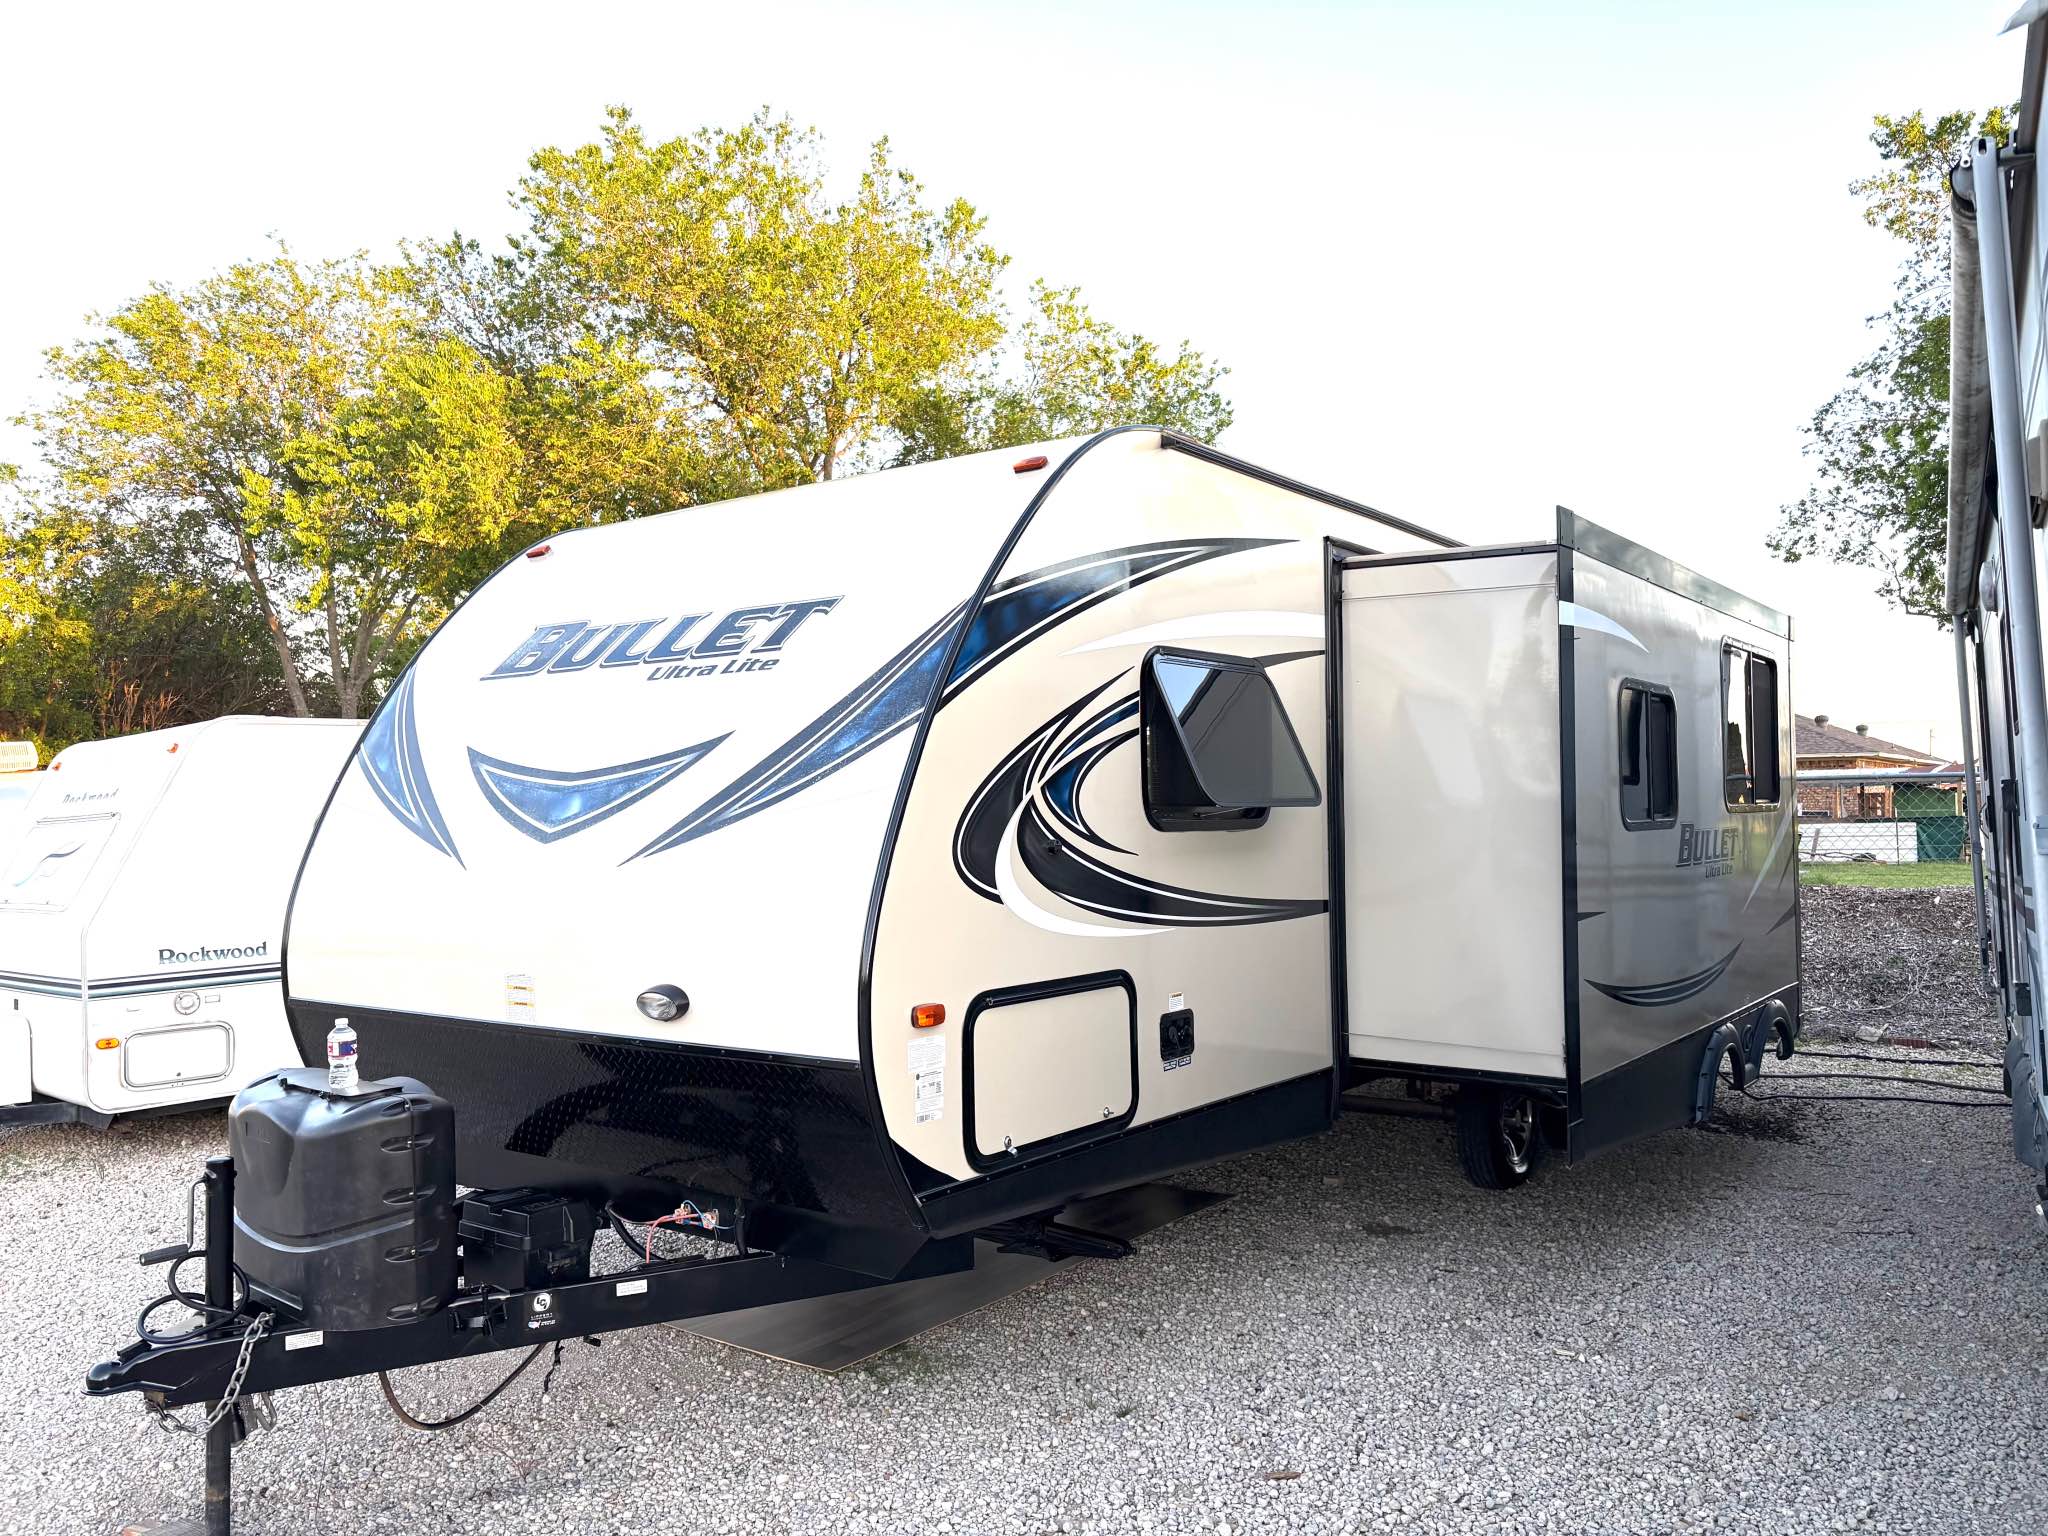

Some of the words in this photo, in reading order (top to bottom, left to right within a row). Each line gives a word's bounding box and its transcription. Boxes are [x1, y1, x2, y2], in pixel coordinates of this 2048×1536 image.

[480, 595, 845, 681] BULLET
[647, 664, 717, 681] Ultra
[720, 658, 780, 674] Lite
[1675, 823, 1739, 868] BULLET
[158, 941, 268, 965] Rockwood
